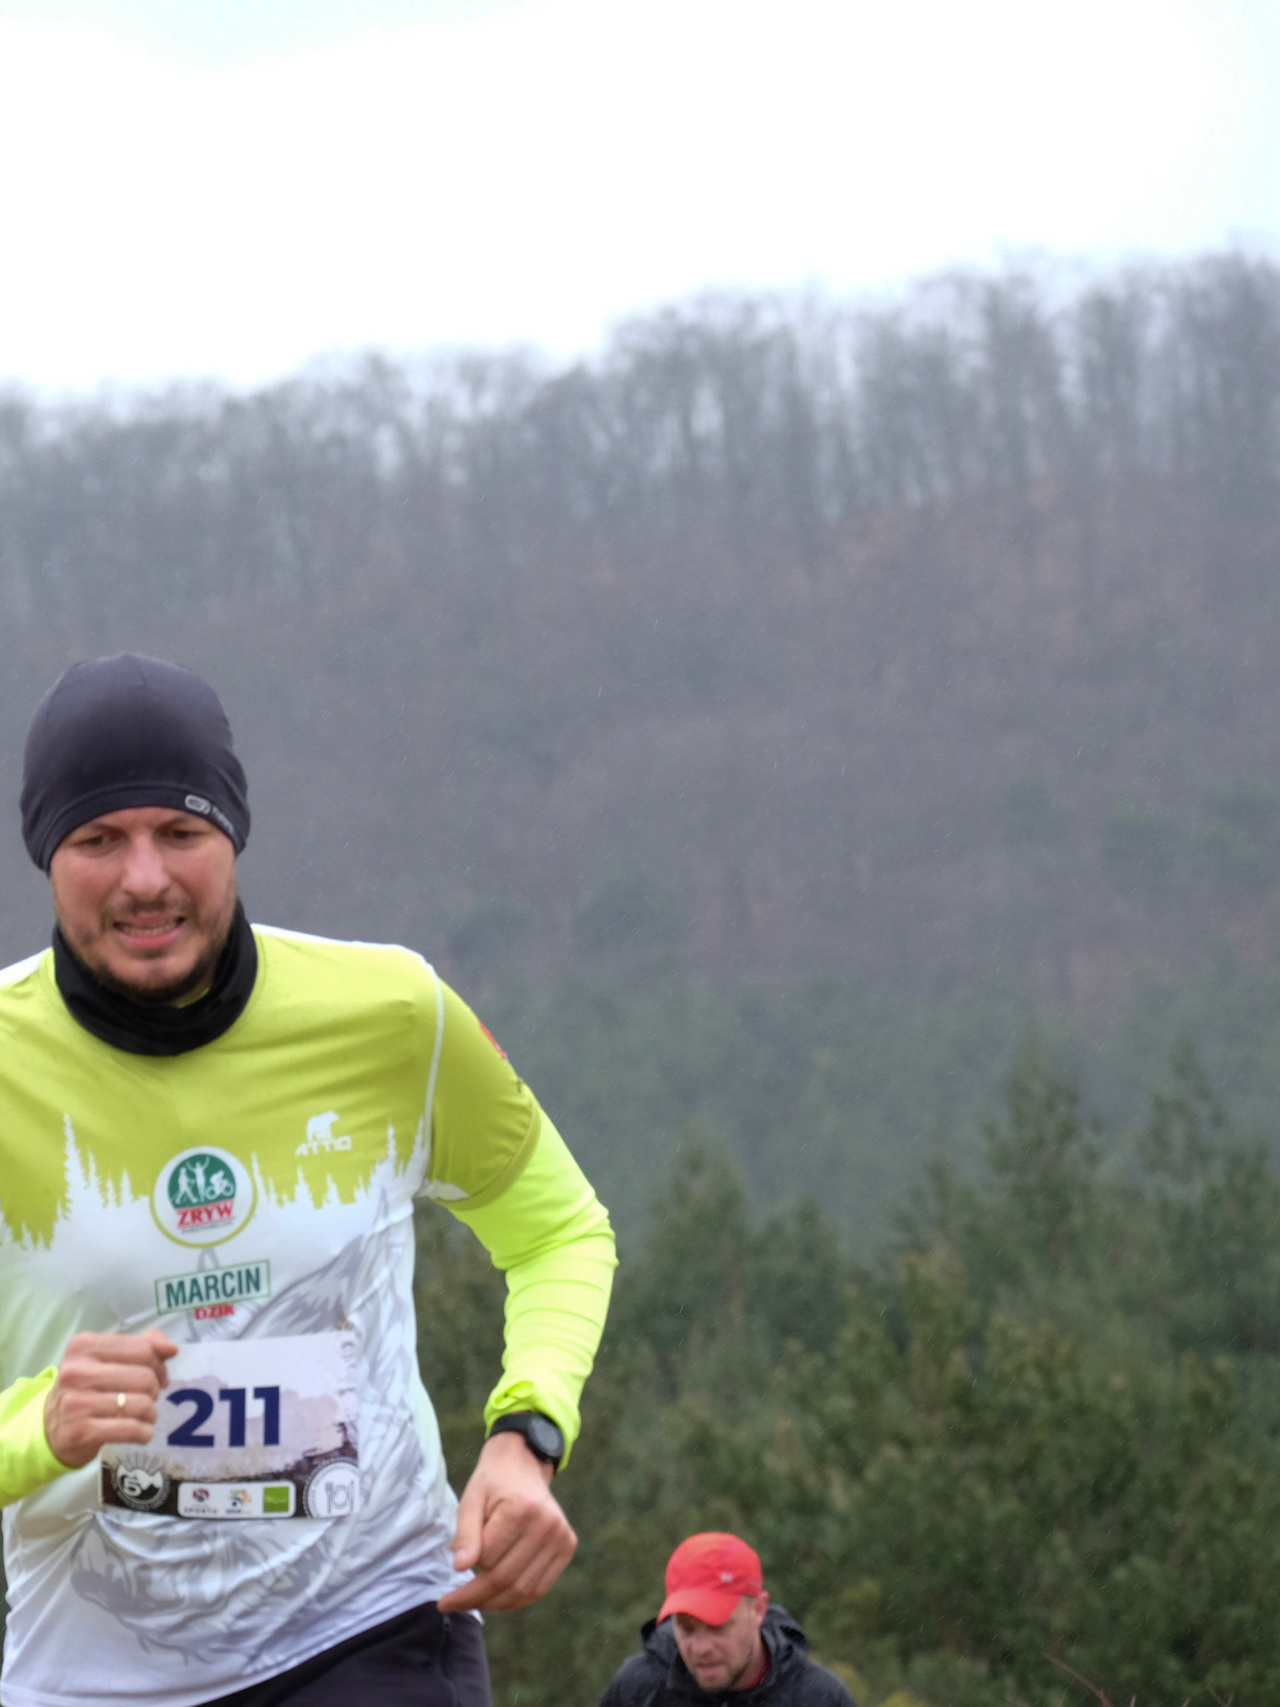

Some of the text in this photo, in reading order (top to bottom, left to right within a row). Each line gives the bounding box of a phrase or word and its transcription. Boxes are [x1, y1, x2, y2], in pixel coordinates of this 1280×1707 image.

[177, 1201, 234, 1229] ZRYW
[165, 1267, 261, 1308] MARCIN
[195, 1303, 235, 1320] DZIK
[166, 1386, 280, 1448] 211
